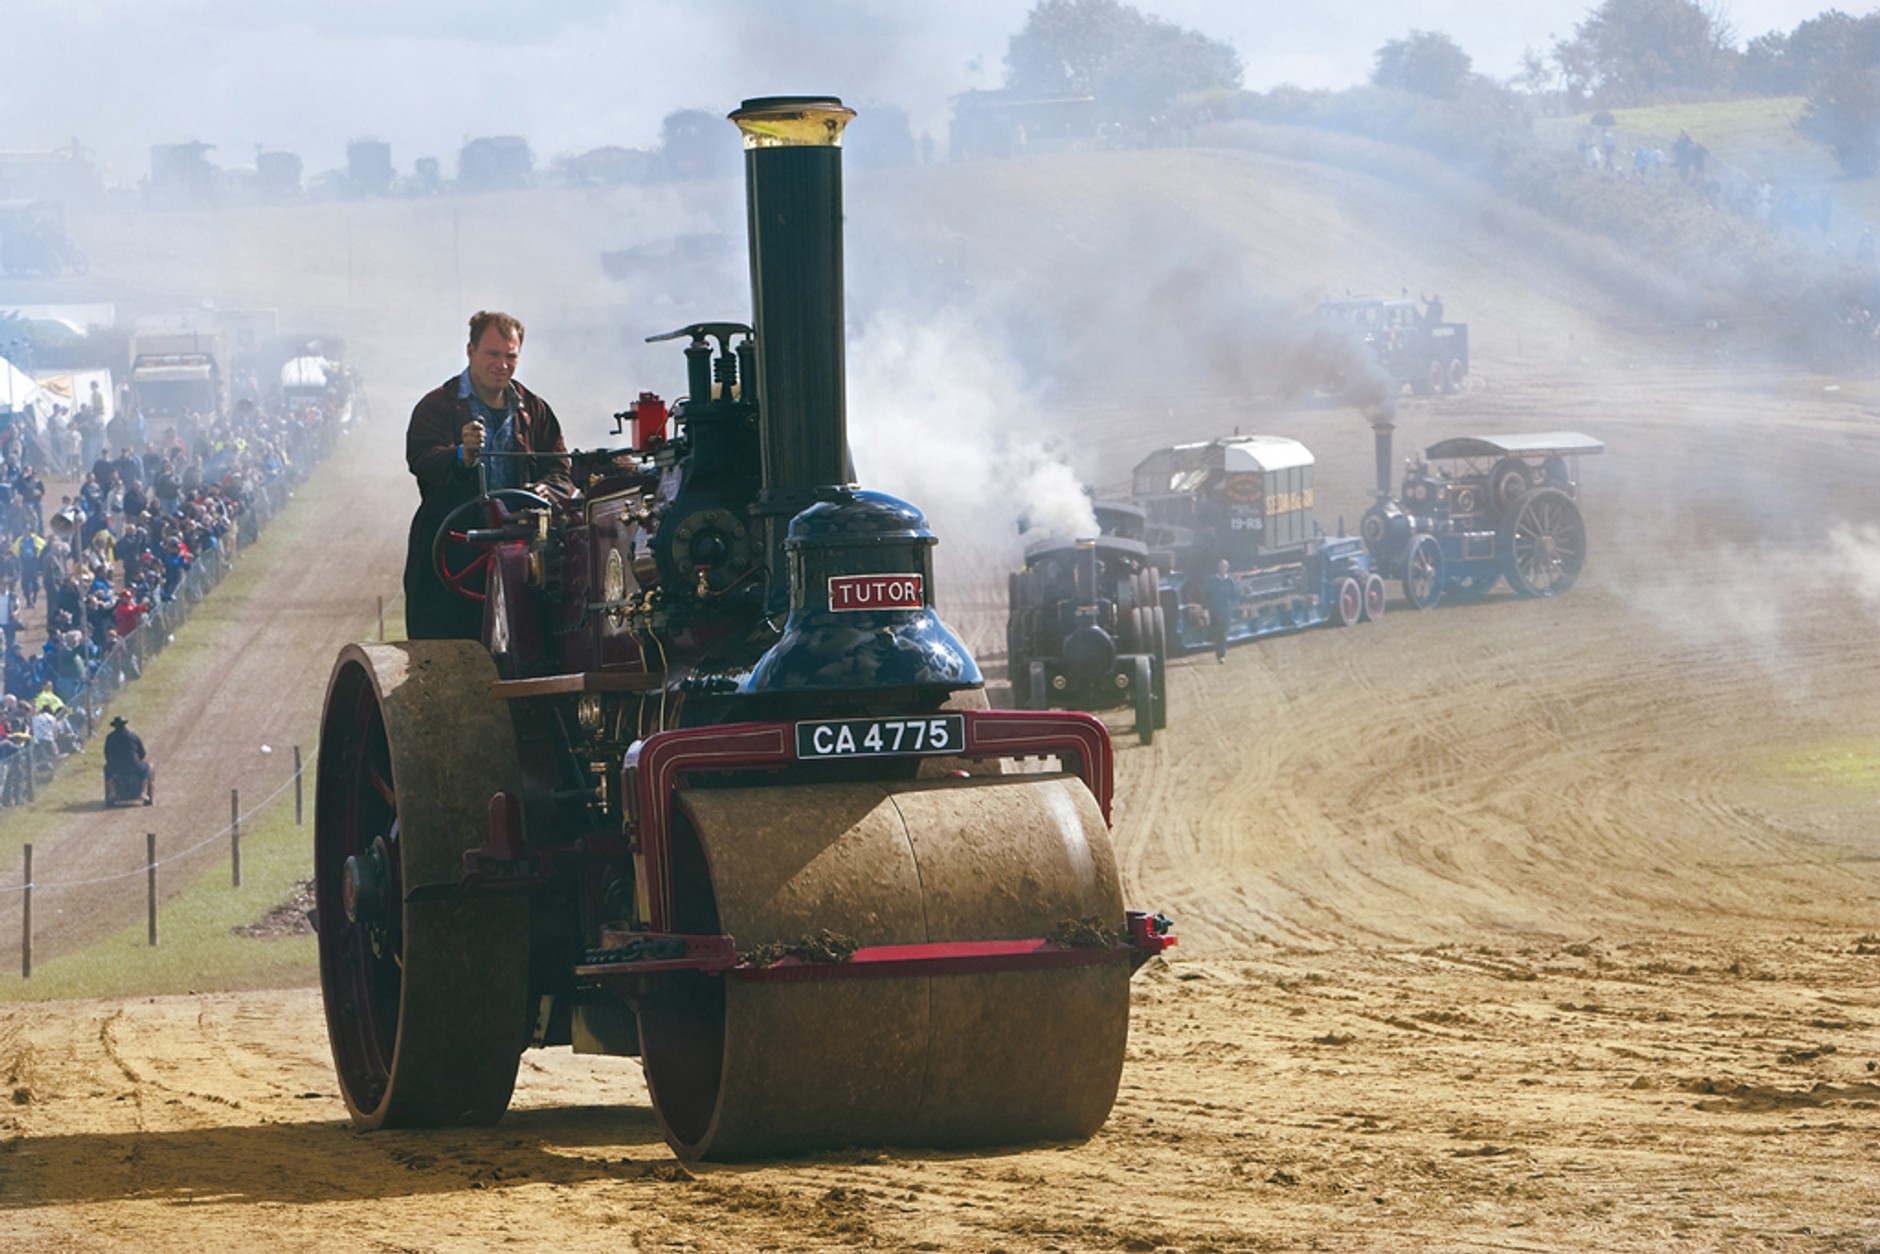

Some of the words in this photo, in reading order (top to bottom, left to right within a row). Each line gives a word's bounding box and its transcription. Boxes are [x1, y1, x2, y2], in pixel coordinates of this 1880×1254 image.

[839, 581, 916, 604] TUTOR
[813, 724, 856, 754] CA
[863, 719, 949, 752] 4775
